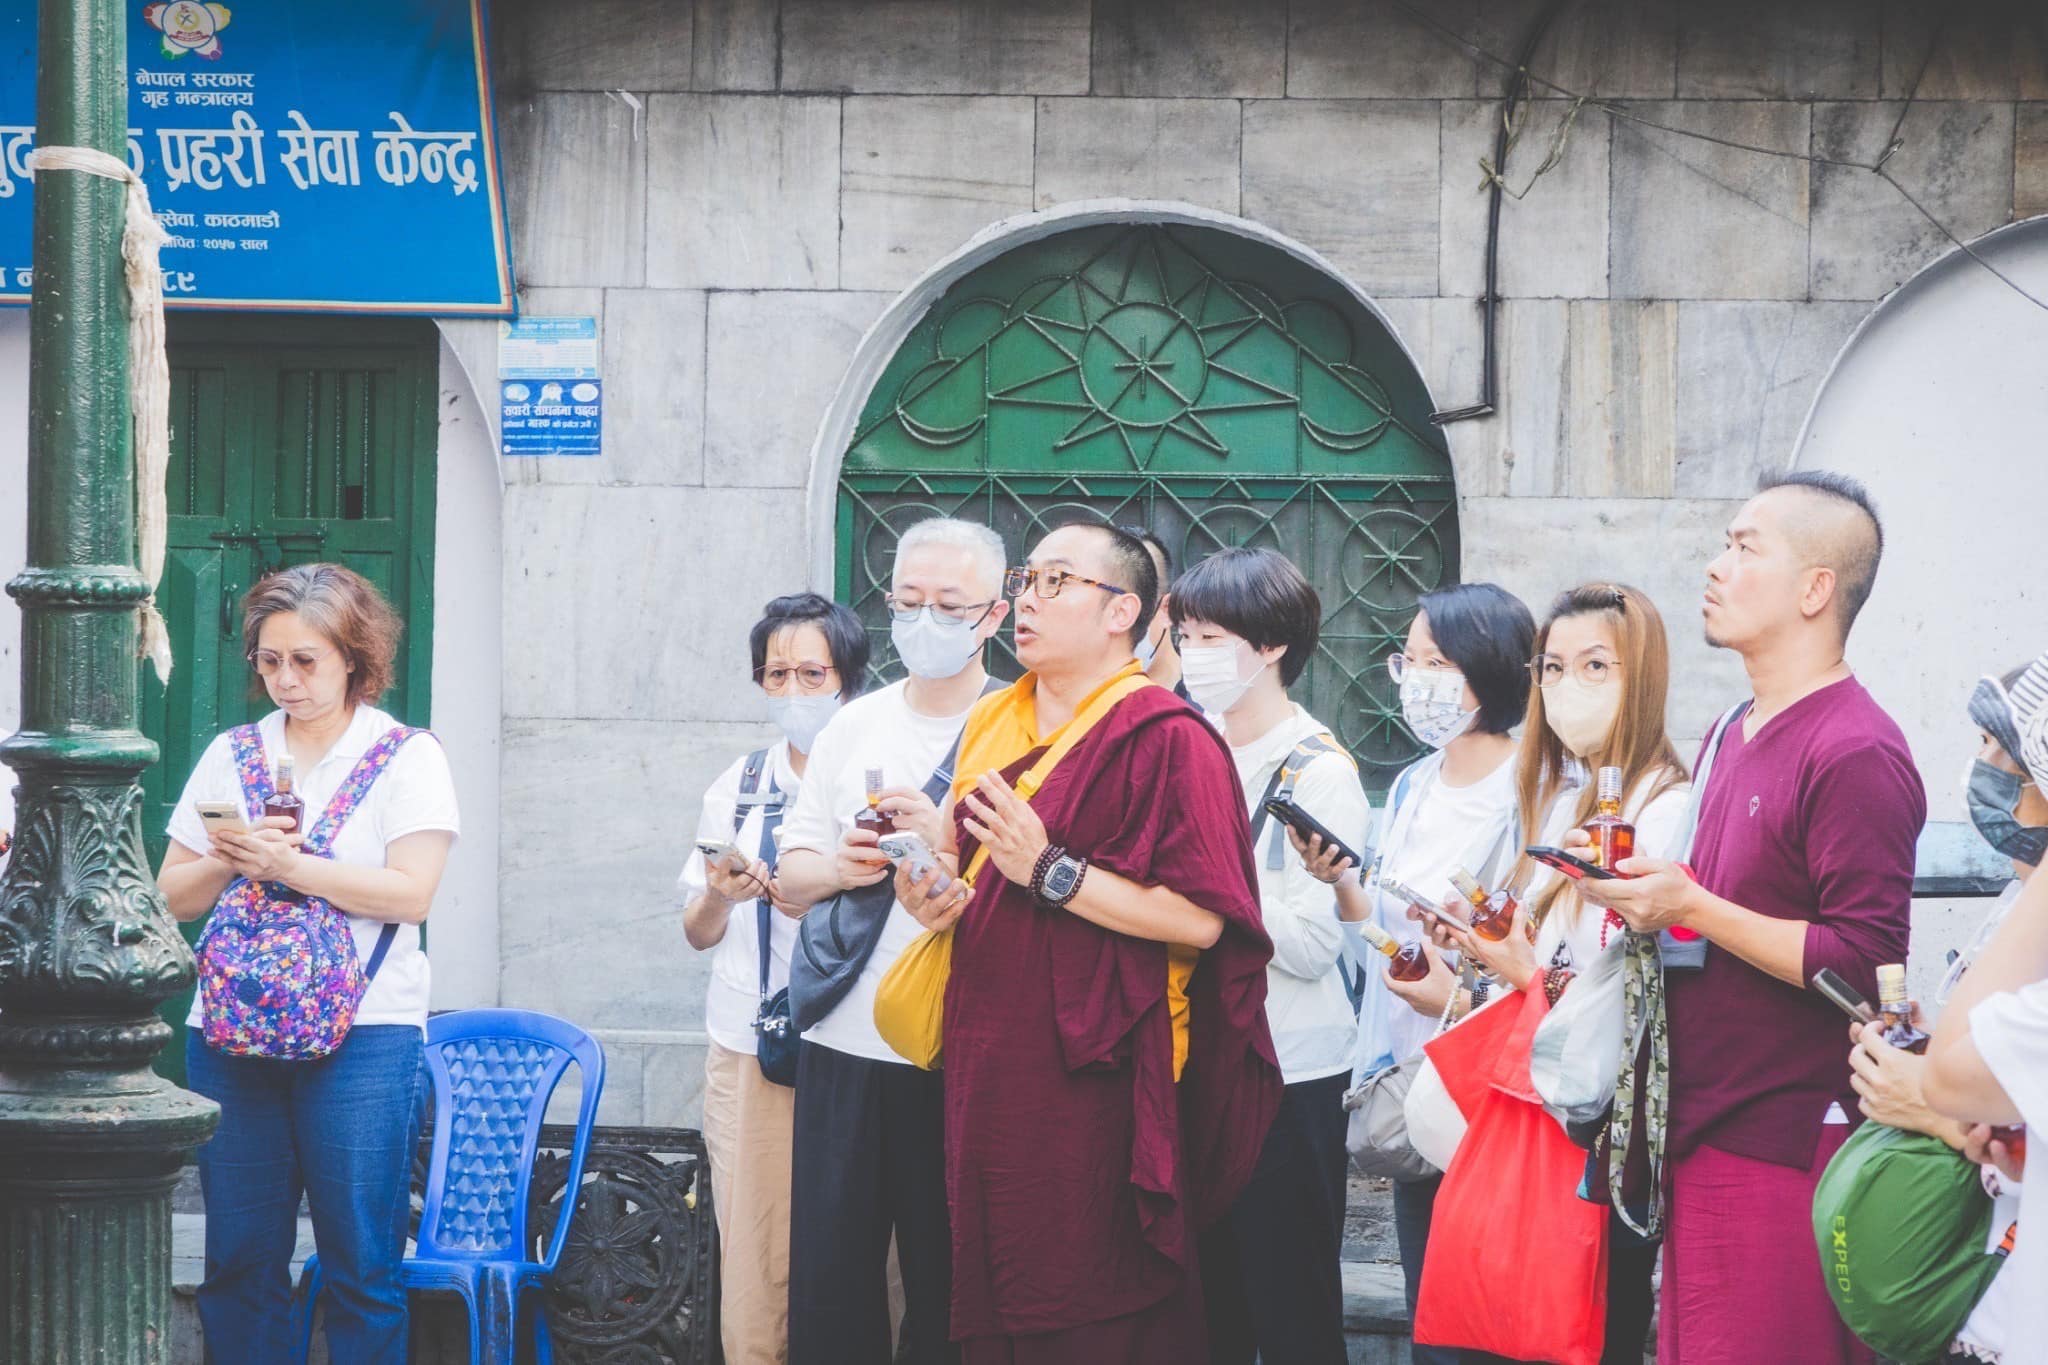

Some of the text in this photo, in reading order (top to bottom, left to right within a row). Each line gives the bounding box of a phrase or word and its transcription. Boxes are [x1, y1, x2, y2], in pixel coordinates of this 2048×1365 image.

[136, 68, 255, 88] नेपाल सरकार
[140, 91, 254, 109] गृह मन्त्रालय
[156, 110, 266, 192] प्रहरी
[277, 109, 361, 190] सेवा
[372, 111, 480, 196] केन्द्र
[239, 239, 269, 251] साल
